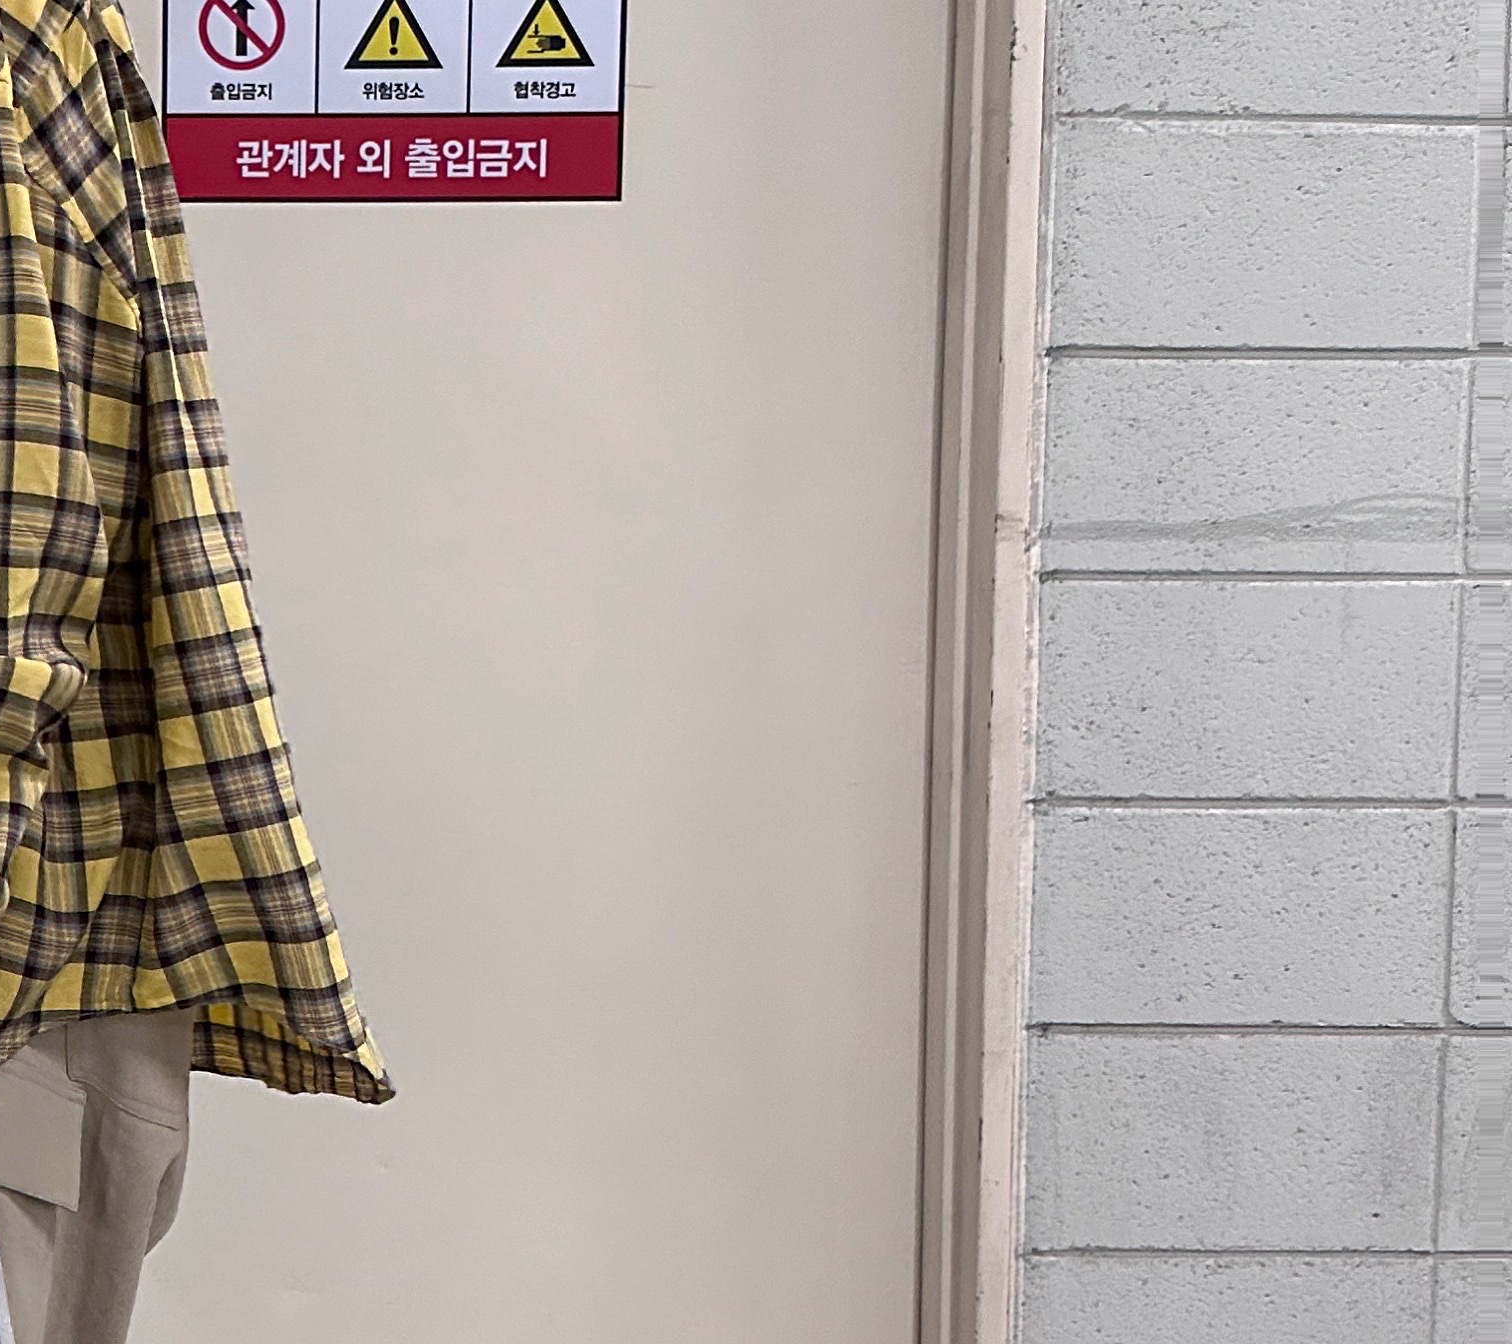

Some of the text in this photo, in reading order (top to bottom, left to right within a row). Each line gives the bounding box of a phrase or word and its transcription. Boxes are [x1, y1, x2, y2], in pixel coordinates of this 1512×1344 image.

[209, 82, 273, 101] 출입금지
[362, 81, 425, 101] 위험장소
[513, 80, 577, 99] 협착경고
[236, 138, 548, 179] 관계자 외 출입금지
